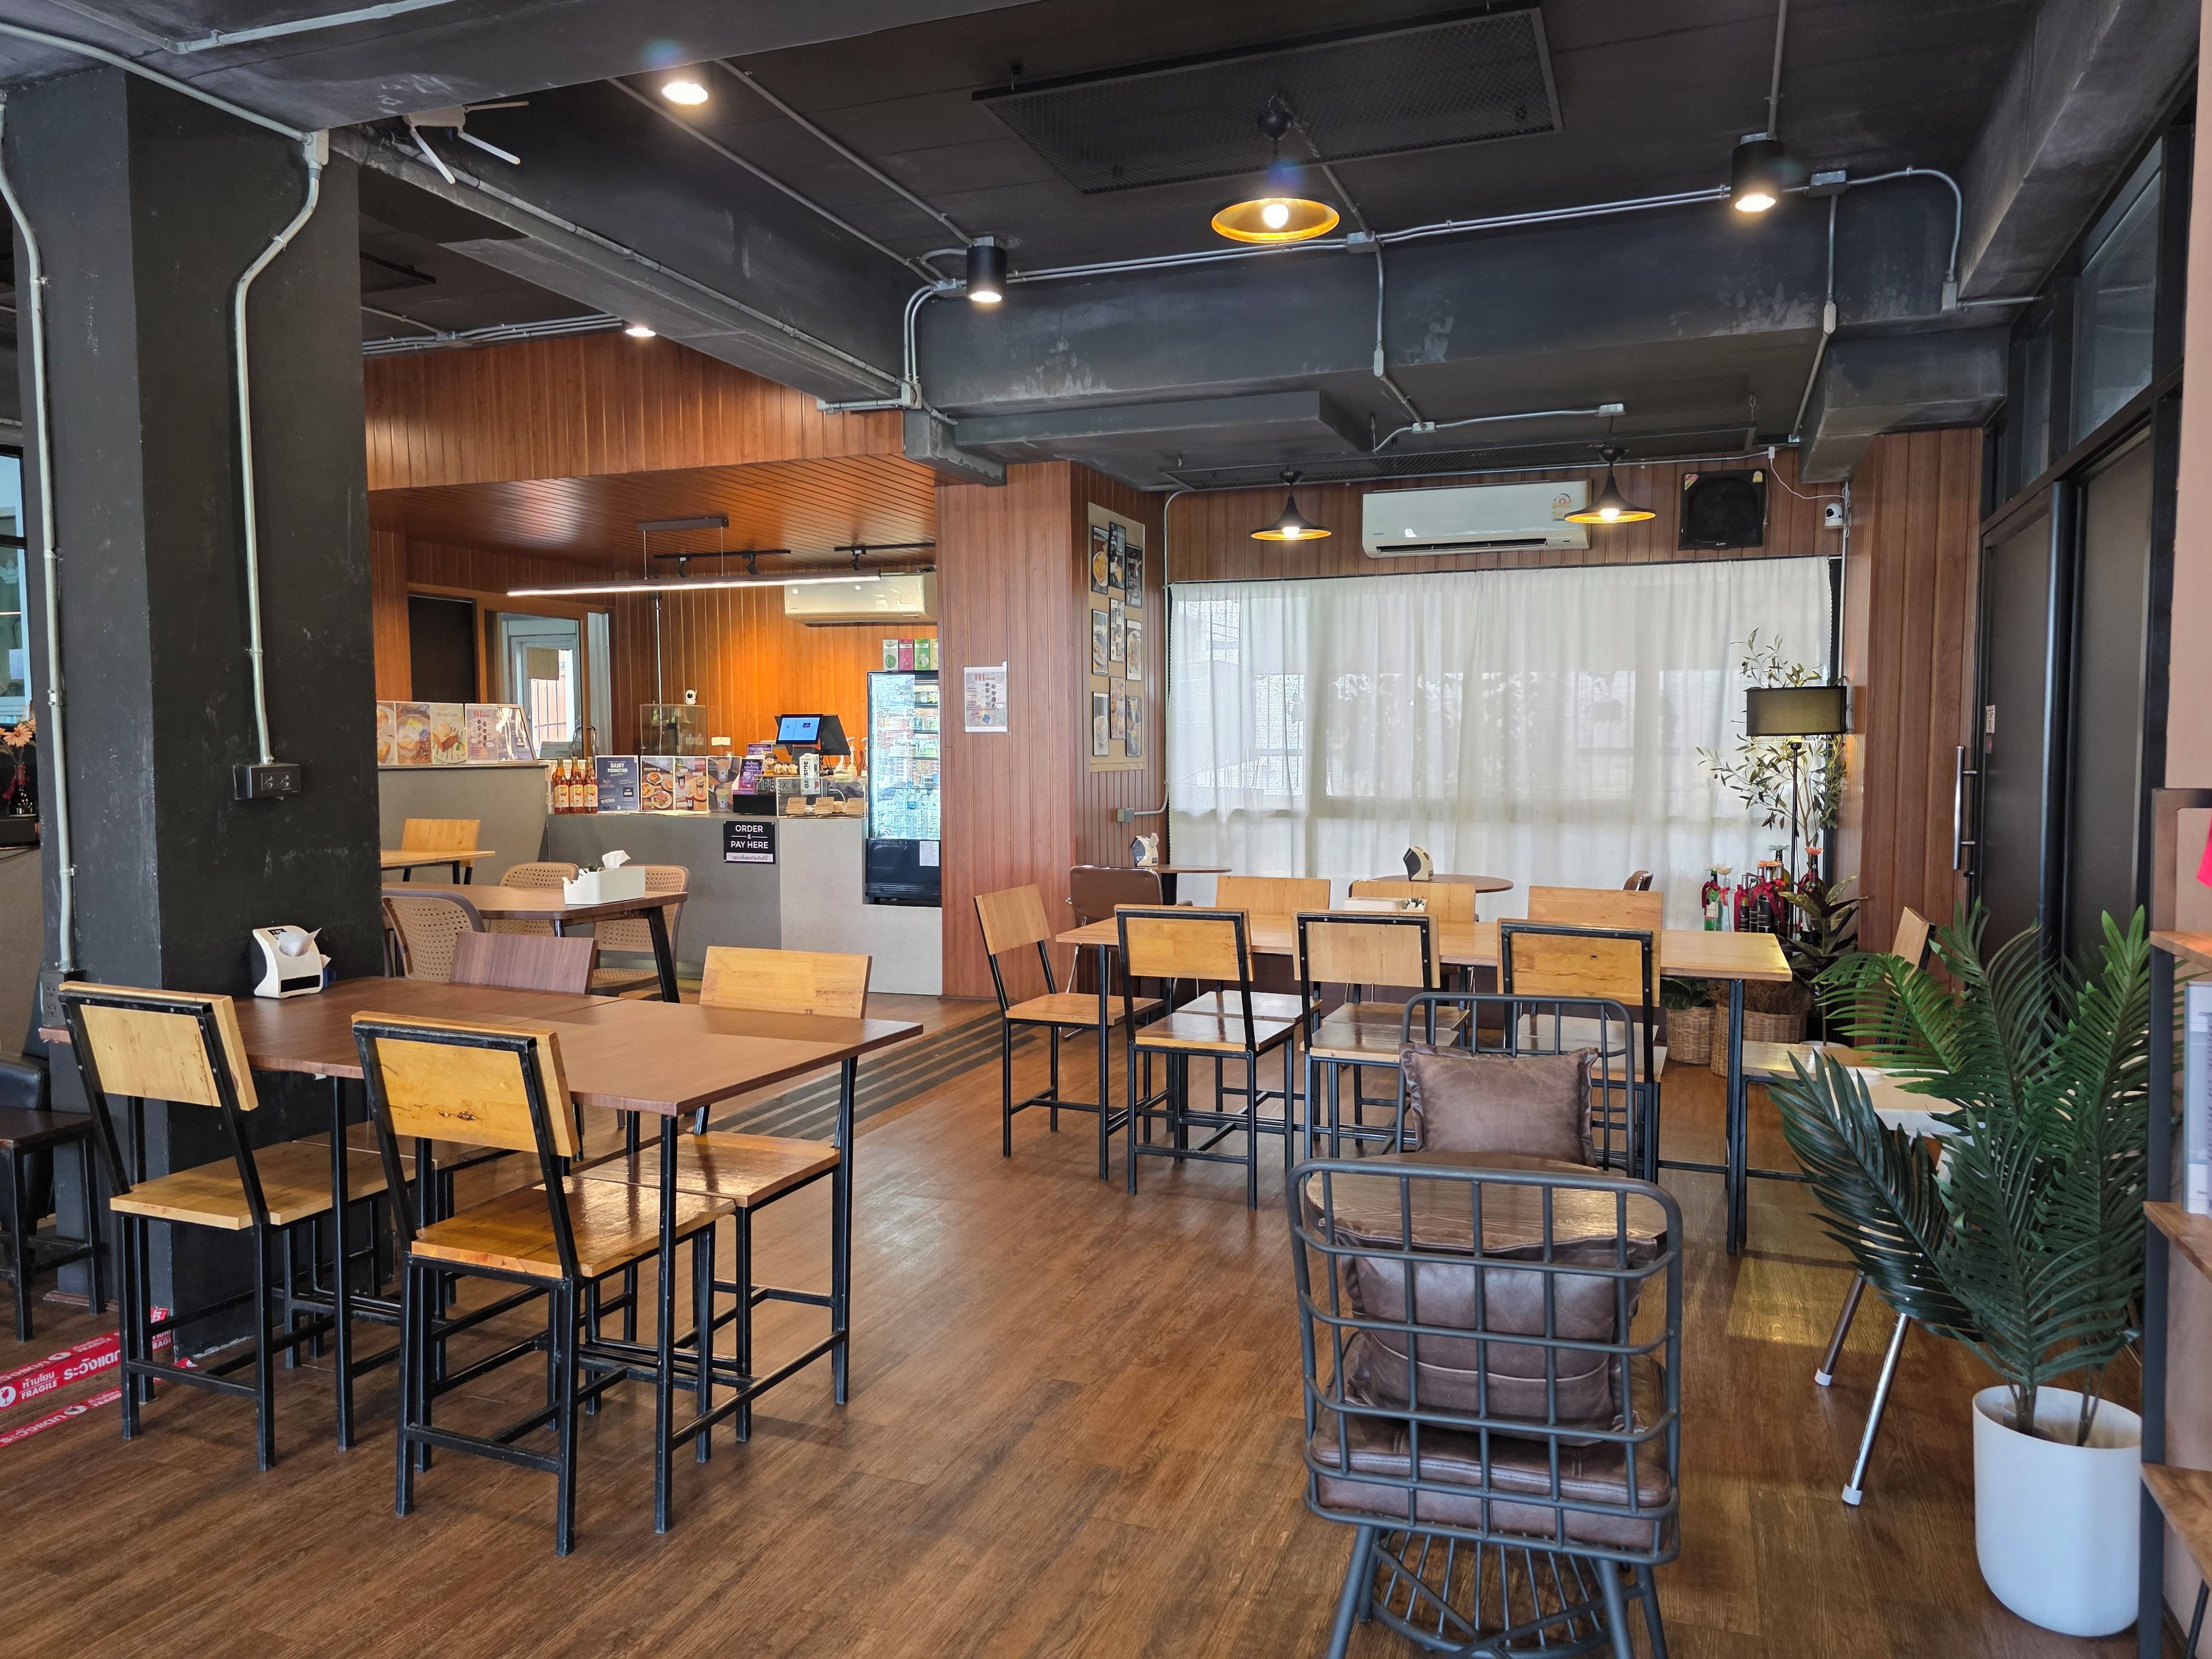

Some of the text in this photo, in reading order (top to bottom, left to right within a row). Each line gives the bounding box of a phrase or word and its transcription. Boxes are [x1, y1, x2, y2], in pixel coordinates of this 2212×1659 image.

[756, 779, 768, 791] TIP
[735, 824, 763, 833] ORDER
[730, 840, 769, 849] PAY HERE
[21, 1379, 58, 1400] FRAGILE
